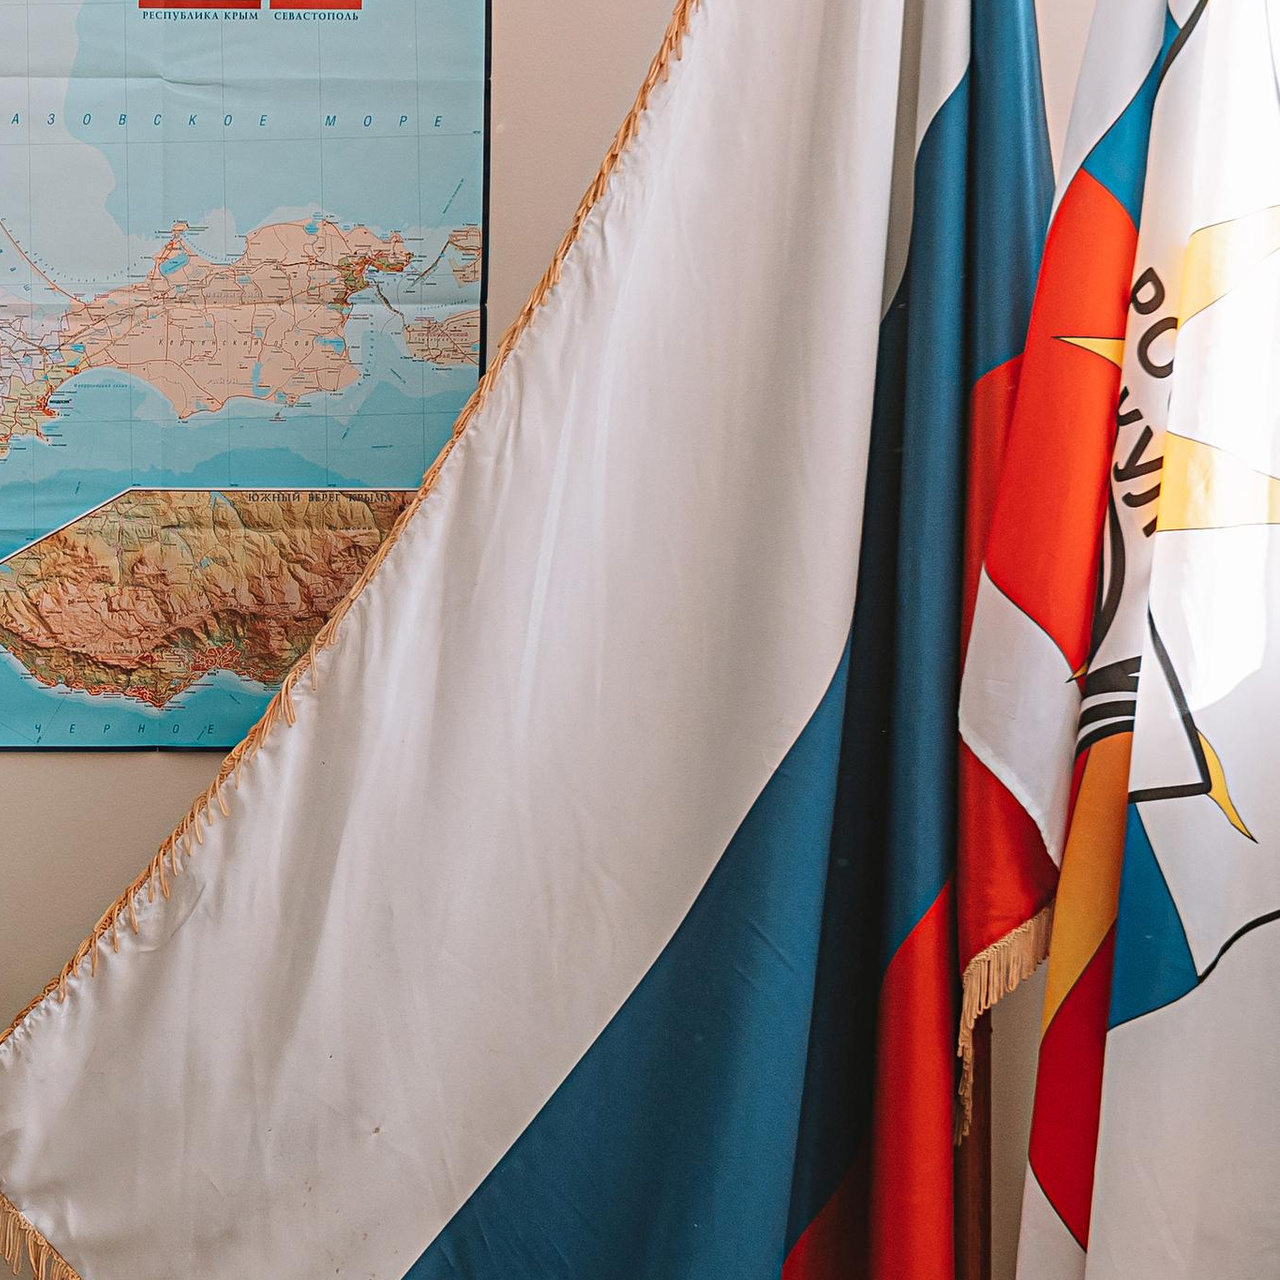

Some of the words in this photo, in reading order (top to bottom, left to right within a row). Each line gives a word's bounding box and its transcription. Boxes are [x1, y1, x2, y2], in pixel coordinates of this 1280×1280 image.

[142, 11, 219, 21] РЕСПУБЛИКА
[224, 11, 259, 21] КРЫМ
[274, 11, 360, 21] СЕВАСТОПОЛЬ
[11, 112, 268, 127] АЗОВСКОЕ
[324, 115, 442, 128] МОРЕ
[248, 493, 301, 502] ЮЖНЫЙ
[308, 493, 340, 502] БЕРЕГ
[349, 493, 392, 502] КРЫМА
[34, 724, 214, 735] ЧЕРНОЕ
